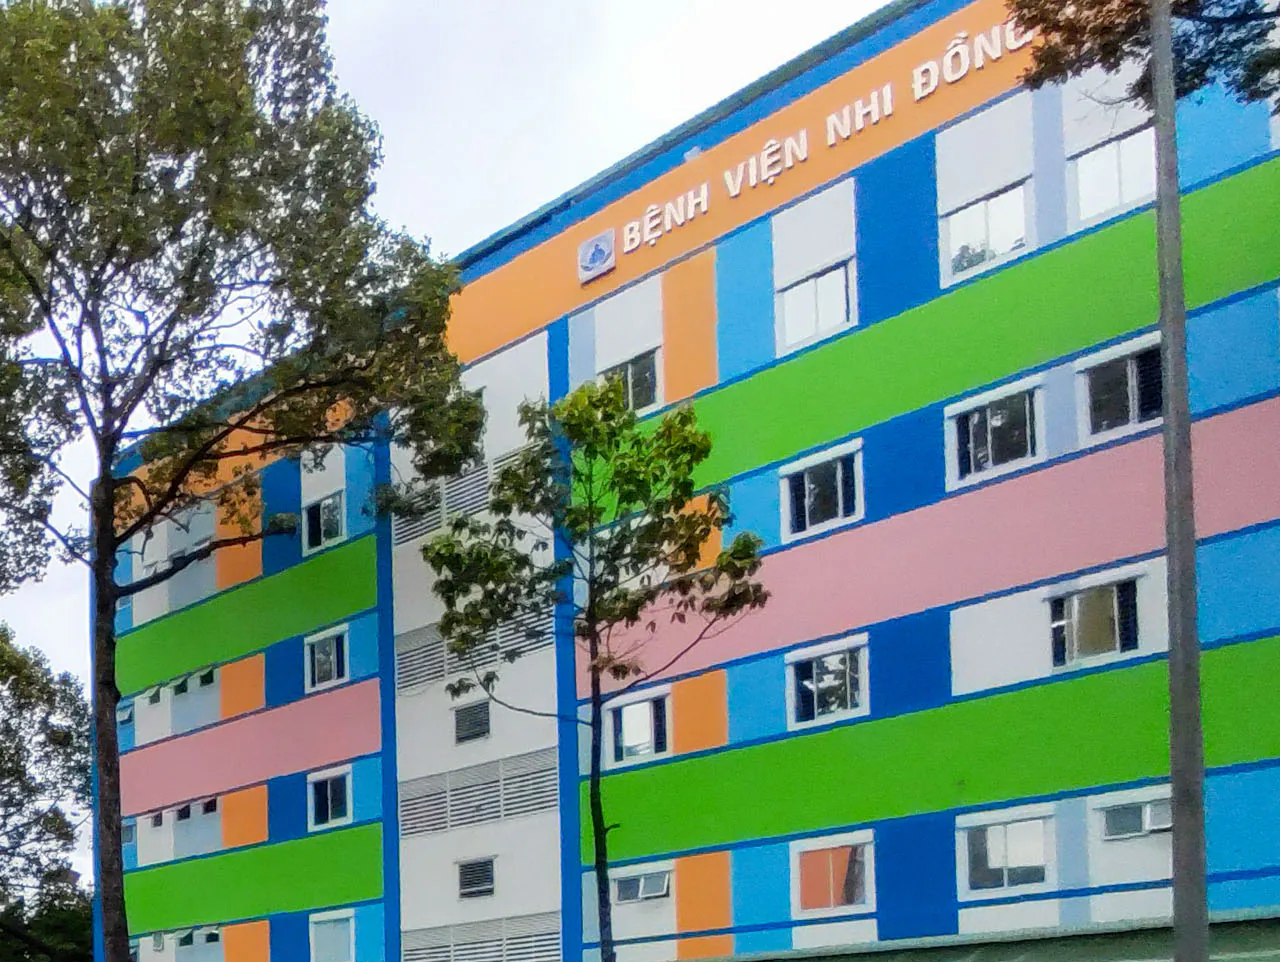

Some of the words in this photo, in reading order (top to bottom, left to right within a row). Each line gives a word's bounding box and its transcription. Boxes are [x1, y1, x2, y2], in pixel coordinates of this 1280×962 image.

[623, 183, 709, 254] BỆNH
[723, 128, 809, 198] VIỆN
[826, 82, 893, 147] NHI
